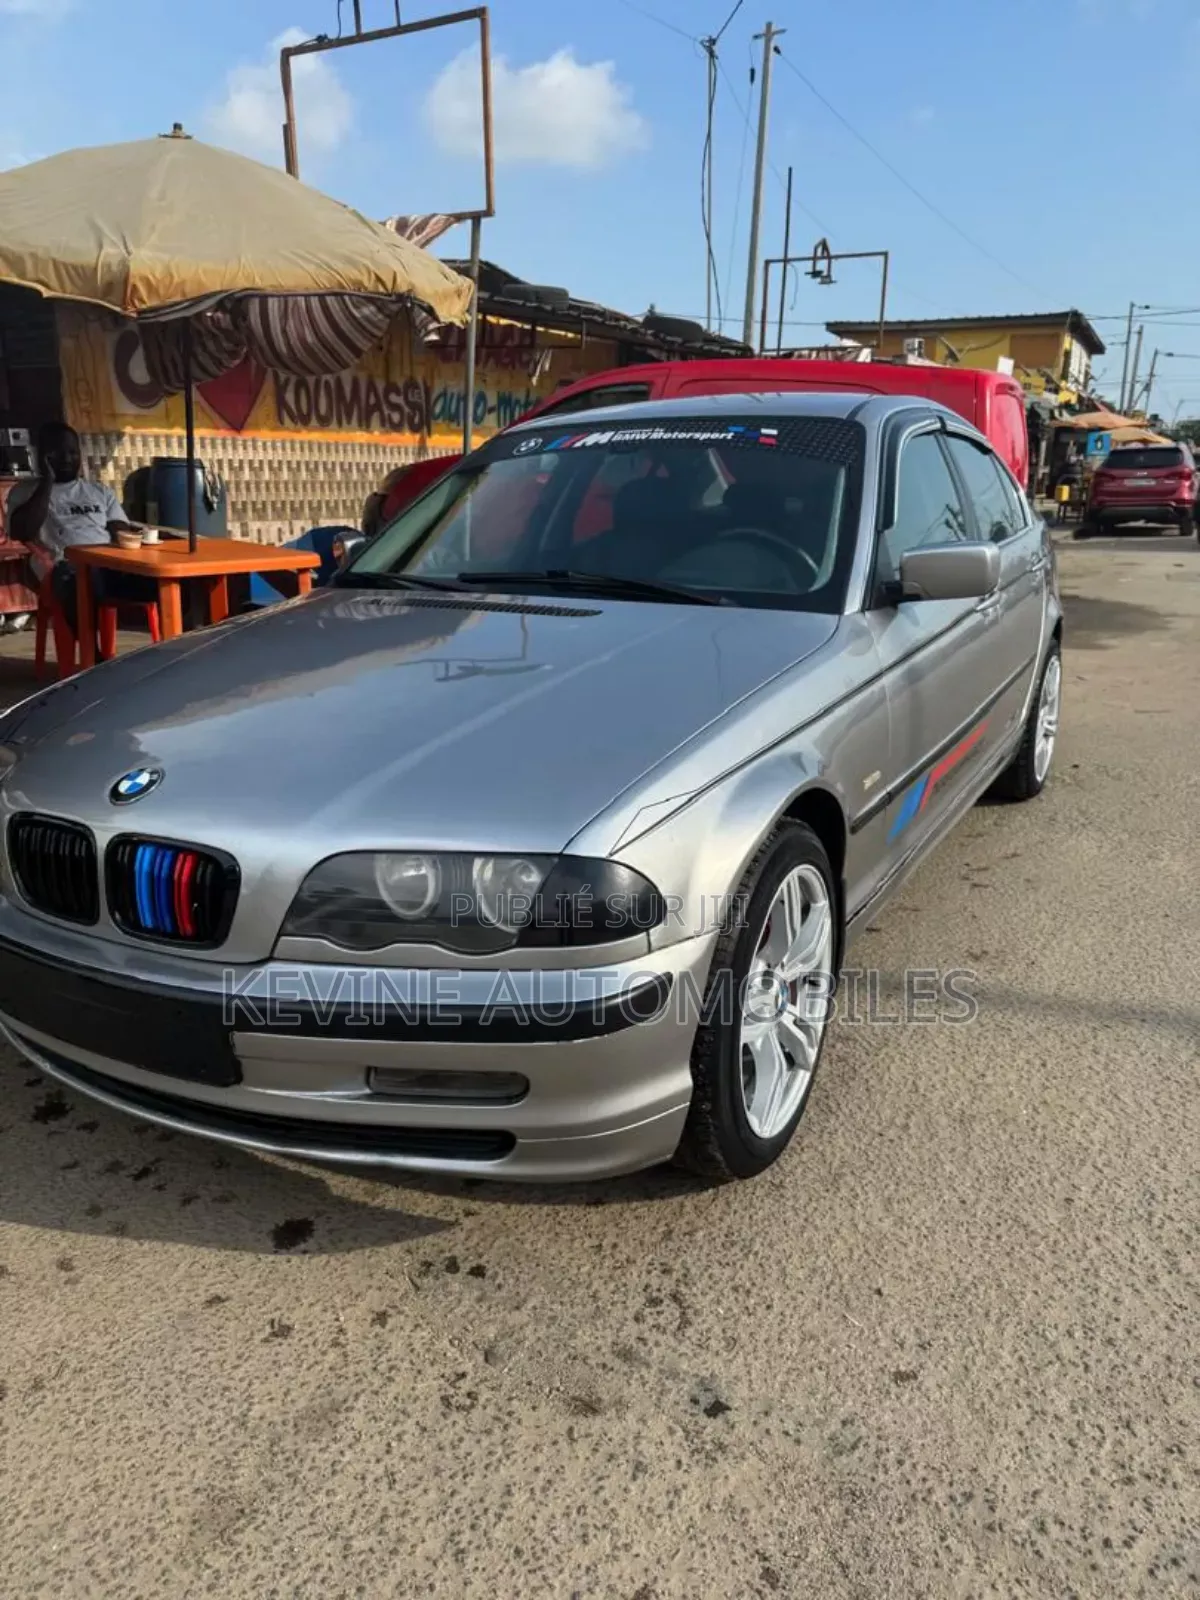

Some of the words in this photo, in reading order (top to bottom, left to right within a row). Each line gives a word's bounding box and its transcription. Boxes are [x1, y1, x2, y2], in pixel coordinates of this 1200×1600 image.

[272, 368, 432, 438] KOUMASSI
[432, 386, 541, 429] auo-mot
[648, 430, 735, 441] Motorsport
